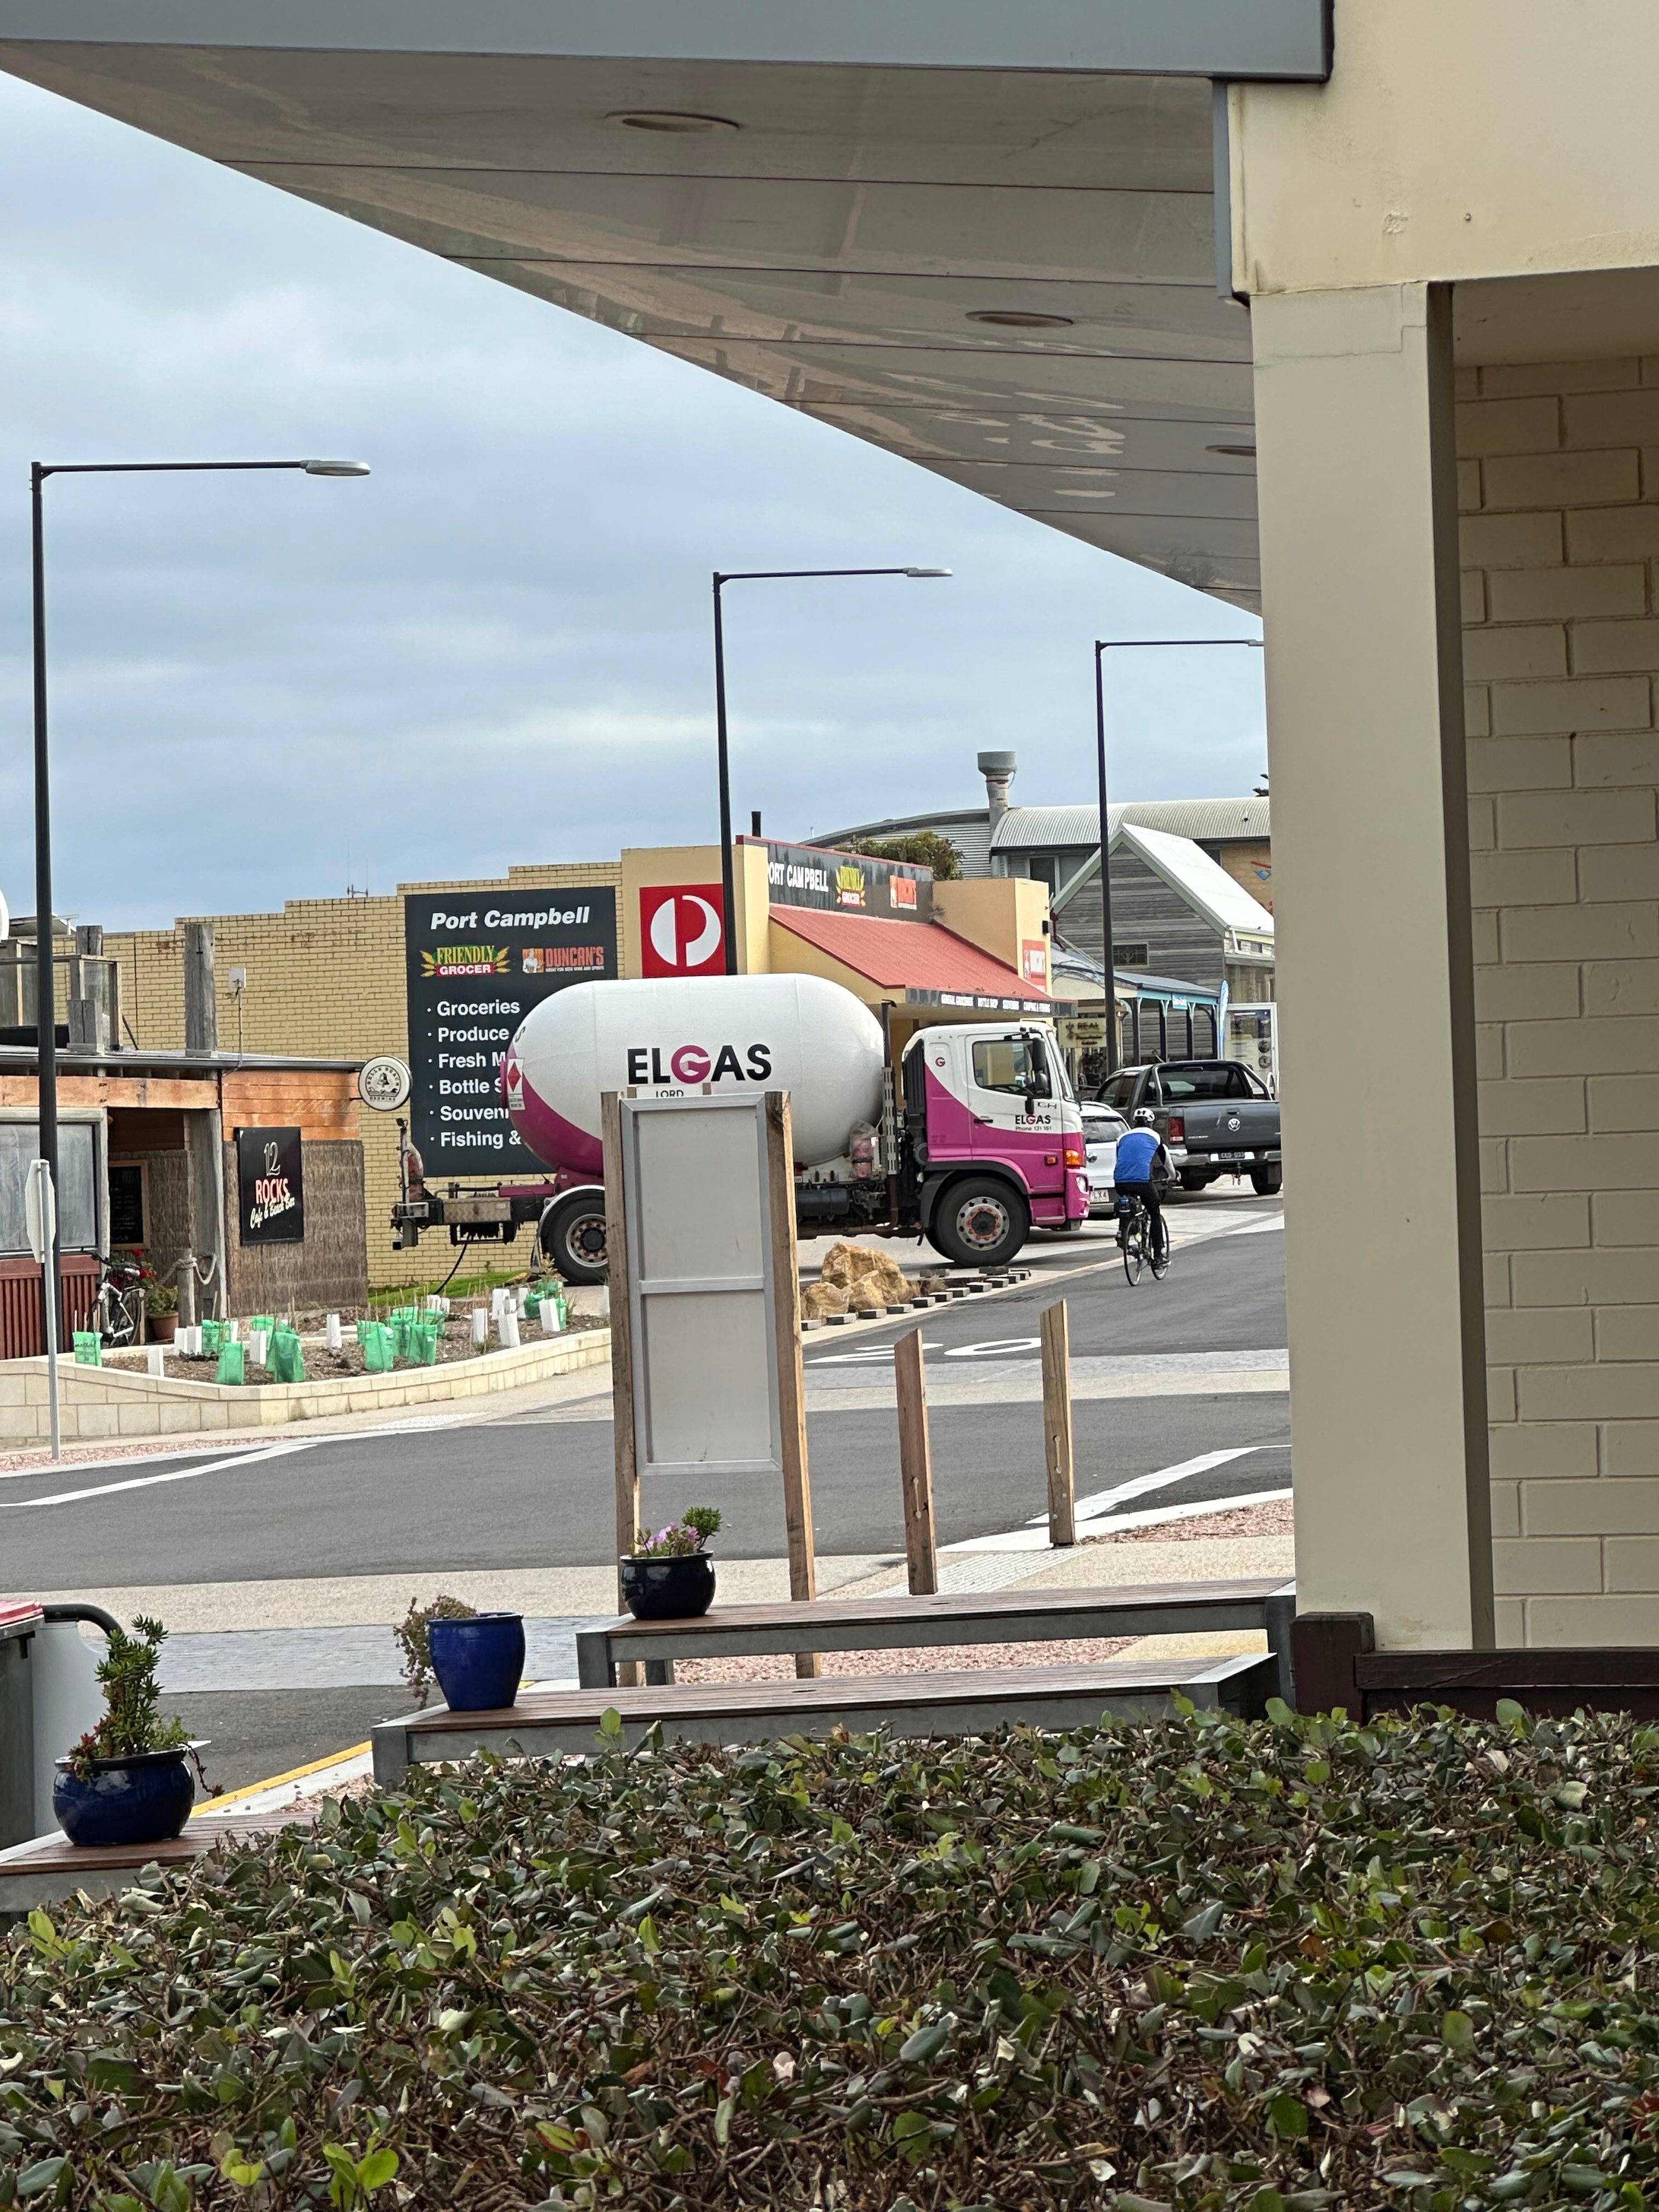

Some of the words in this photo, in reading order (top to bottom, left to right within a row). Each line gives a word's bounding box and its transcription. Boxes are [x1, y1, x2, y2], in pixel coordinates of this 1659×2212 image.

[768, 861, 785, 885] ORT
[787, 864, 829, 893] CAMPBELL
[431, 912, 478, 930] Port
[484, 906, 590, 929] Campbell
[436, 945, 495, 965] FRIENDLY
[545, 946, 604, 967] DUNCAN'S
[439, 964, 492, 975] GROCER
[437, 999, 520, 1016] Groceries
[438, 1026, 509, 1042] Produce
[438, 1052, 487, 1069] Fresh
[628, 1043, 772, 1085] ELGAS
[439, 1079, 490, 1094] Bottle
[440, 1105, 509, 1121] Souveni
[1015, 1115, 1052, 1124] ELGAS
[441, 1131, 503, 1149] Fishing
[509, 1130, 522, 1146] &
[264, 1142, 280, 1176] 12
[256, 1178, 289, 1204] ROCKS
